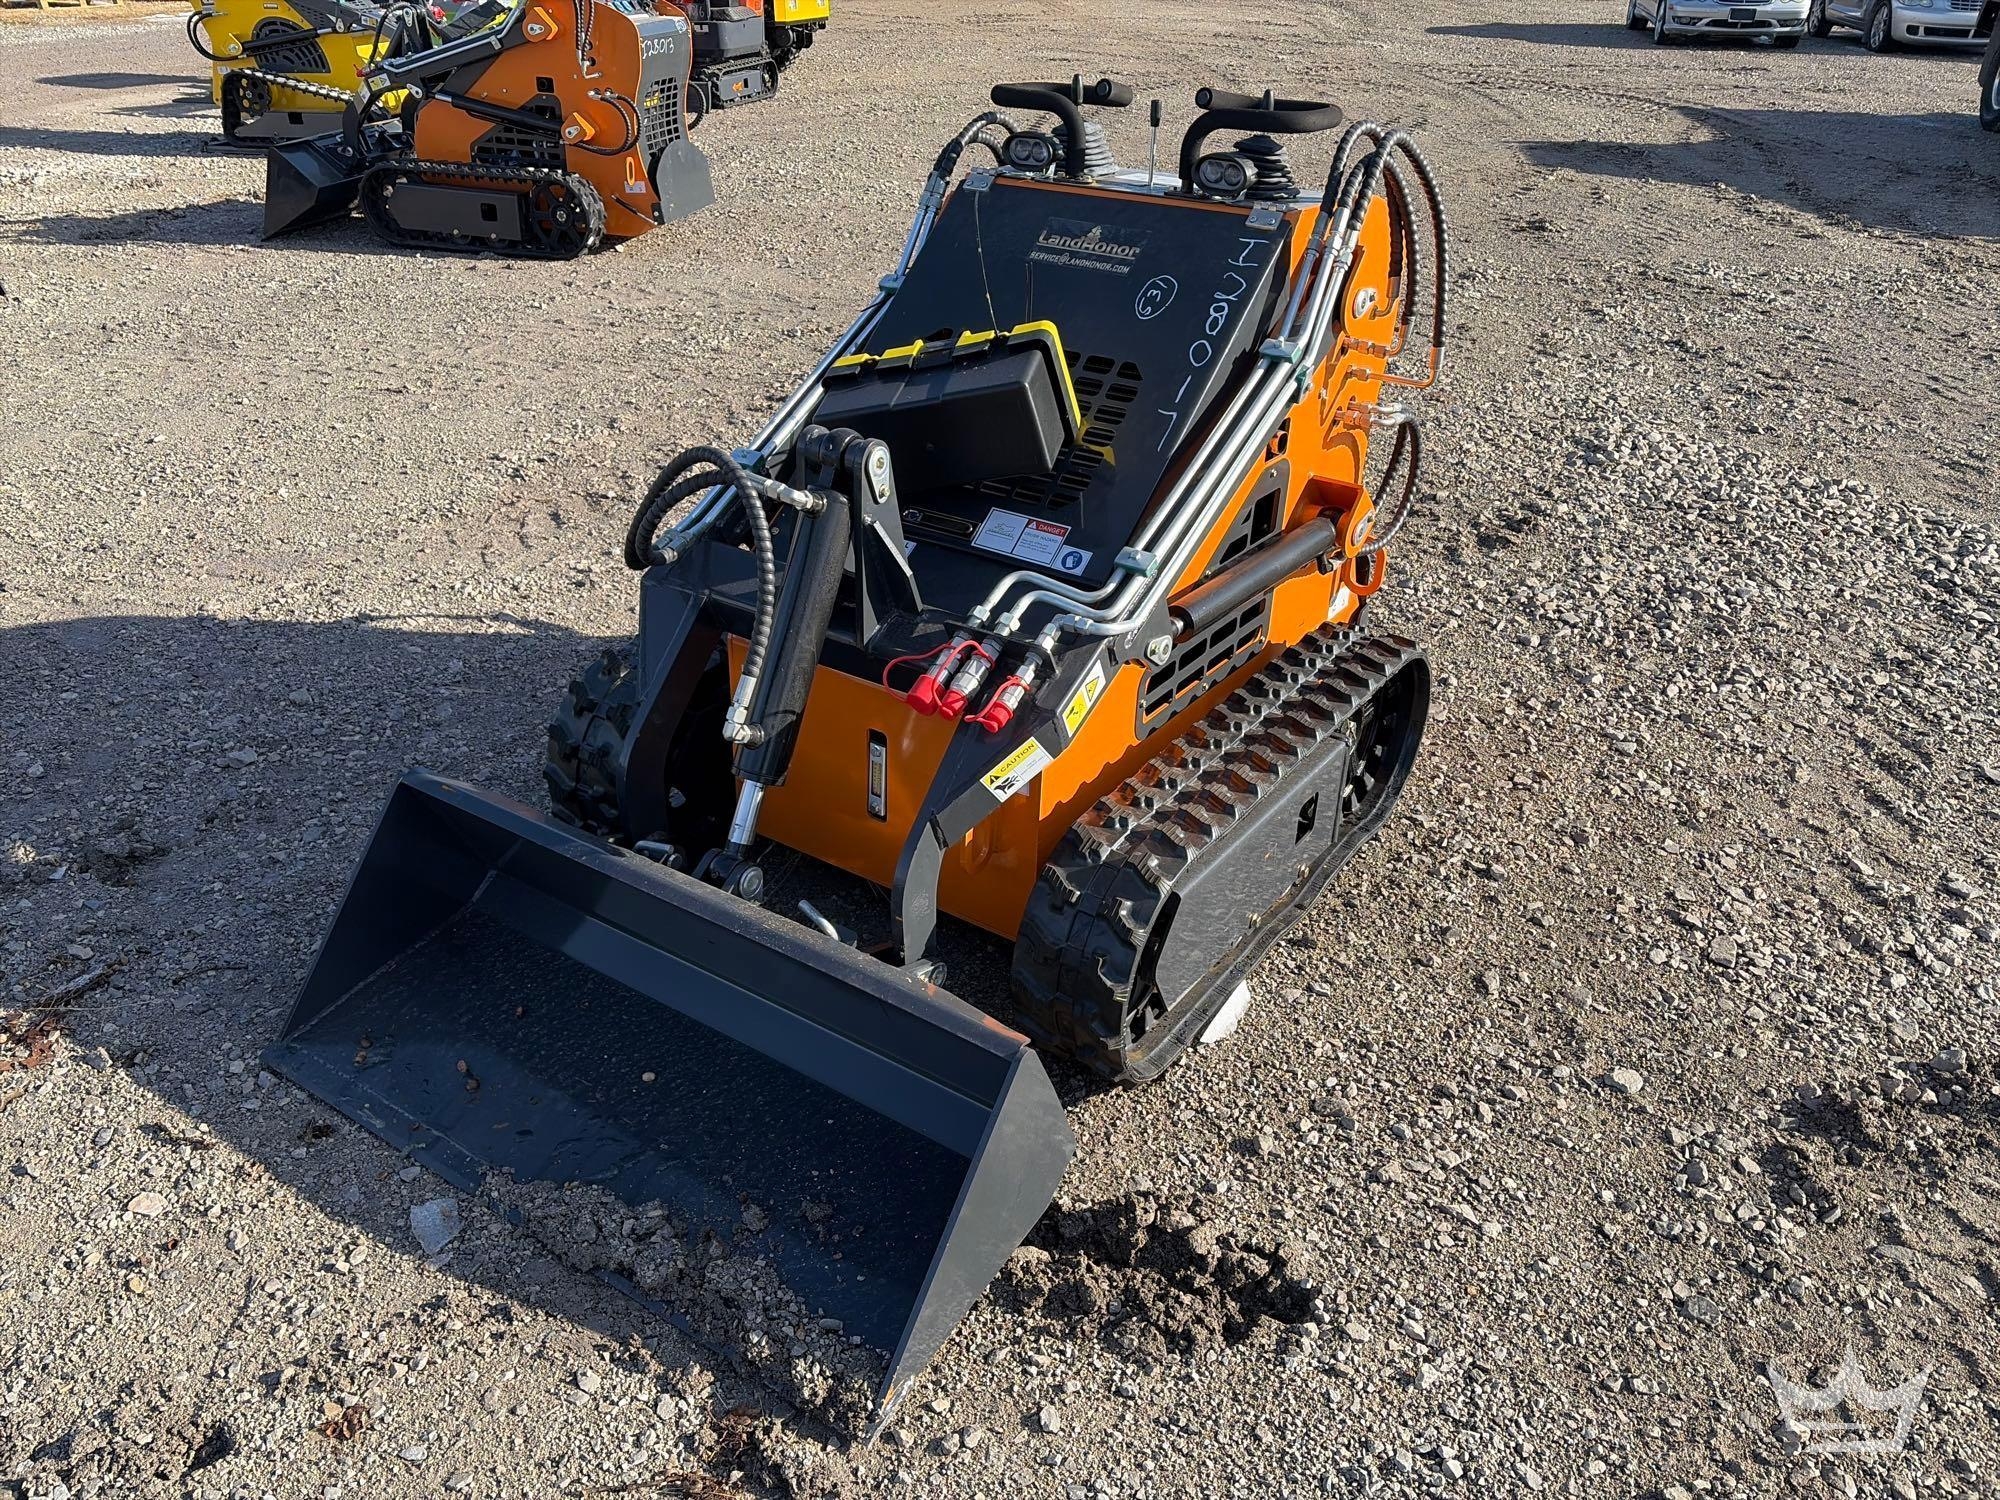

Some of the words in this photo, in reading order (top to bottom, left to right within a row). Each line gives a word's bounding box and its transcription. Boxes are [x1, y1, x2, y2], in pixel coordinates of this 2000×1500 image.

[1038, 230, 1141, 257] LandHonor
[1029, 251, 1131, 274] SERVICE@LANDHONOR.COM
[1038, 524, 1065, 536] DANGER
[1000, 743, 1035, 773] CAUTION
